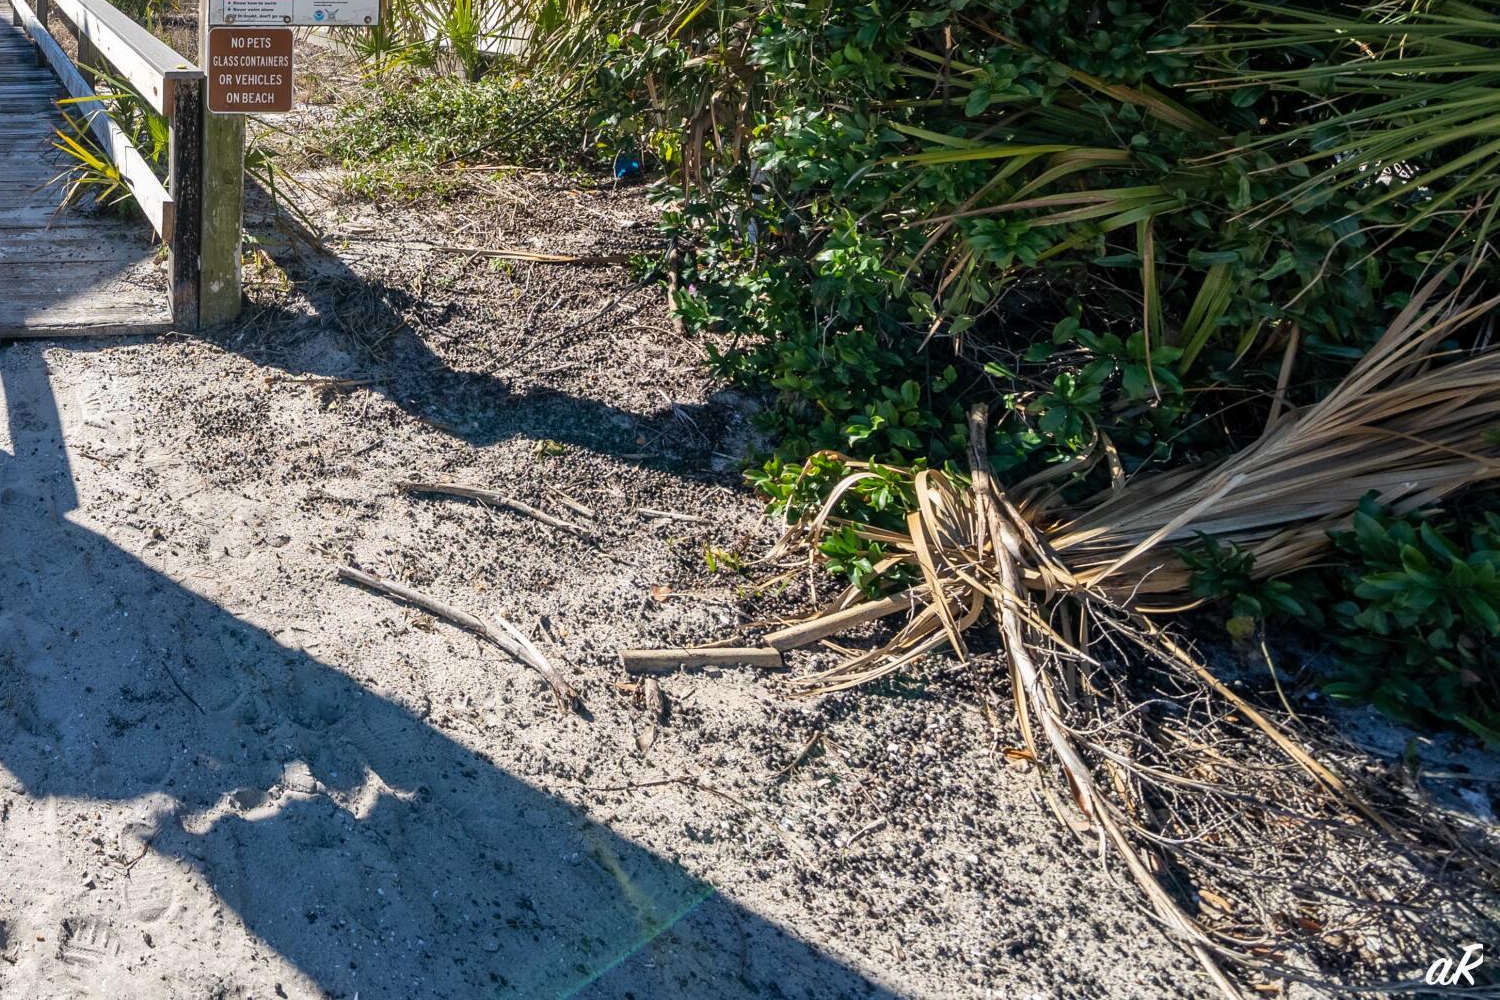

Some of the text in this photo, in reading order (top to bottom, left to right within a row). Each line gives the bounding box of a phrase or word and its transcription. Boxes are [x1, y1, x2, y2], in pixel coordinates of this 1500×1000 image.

[231, 37, 271, 48] NO PETS
[213, 56, 288, 67] GLASS CONTAINERS
[219, 75, 282, 85] OR VEHICLES
[227, 93, 274, 103] ON BEACH
